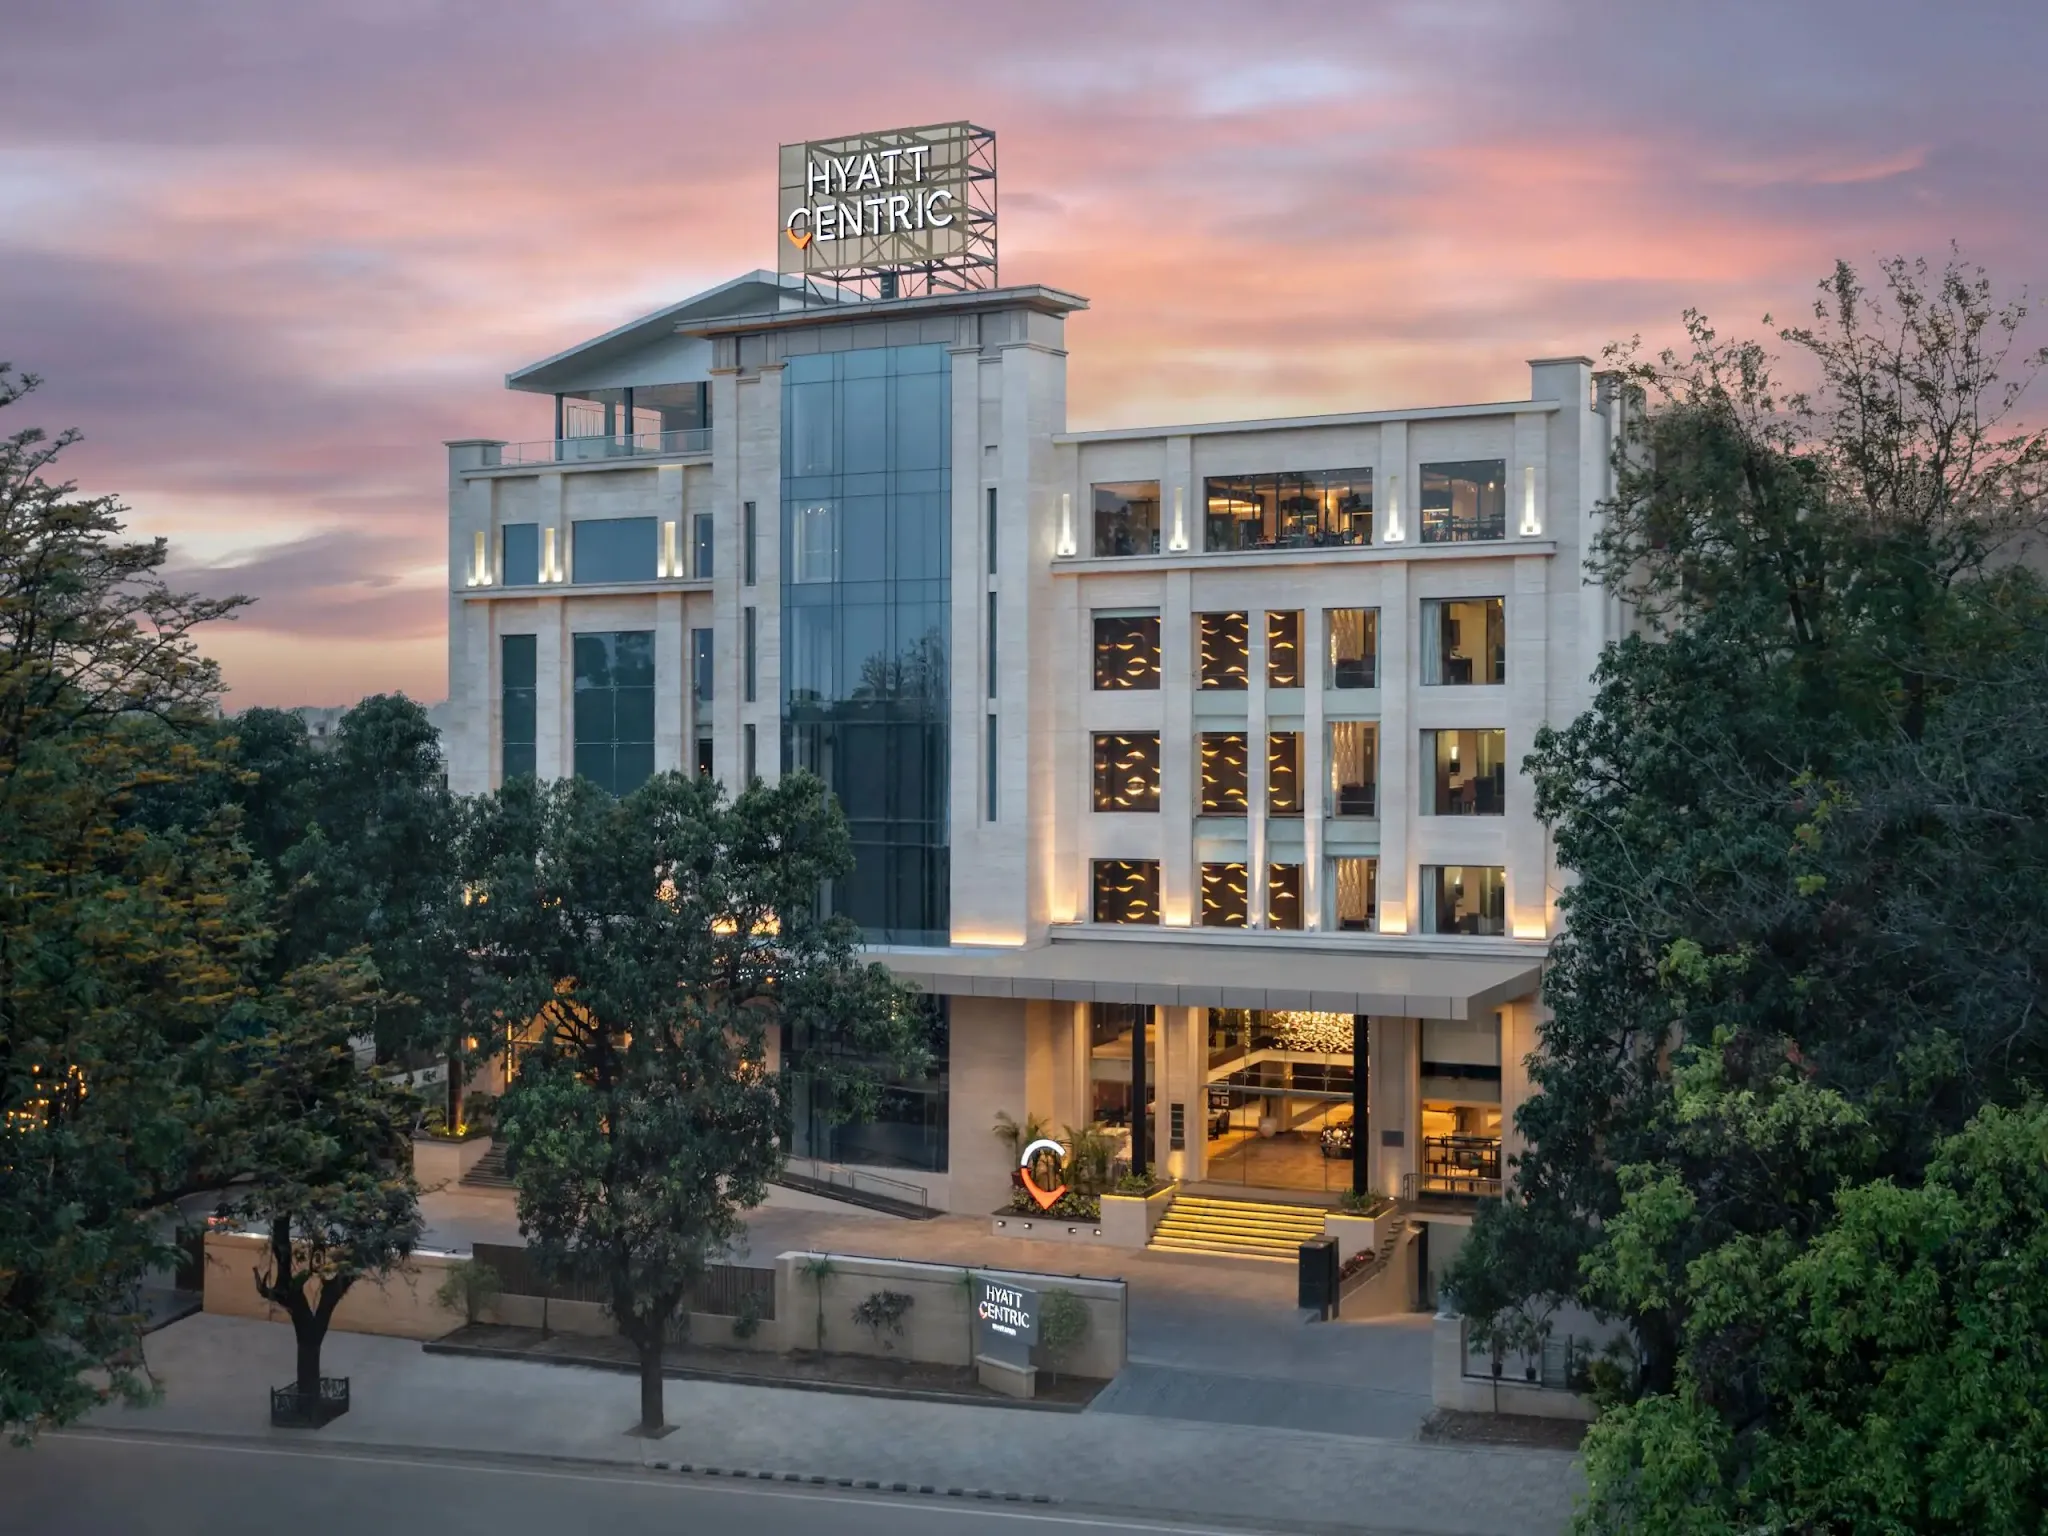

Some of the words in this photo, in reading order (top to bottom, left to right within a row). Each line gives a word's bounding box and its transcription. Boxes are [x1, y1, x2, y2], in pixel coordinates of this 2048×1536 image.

[808, 146, 929, 196] HYATT
[787, 190, 953, 249] CENTRIC
[979, 1301, 1030, 1328] CENTRIC
[986, 1284, 1022, 1308] HYATT
